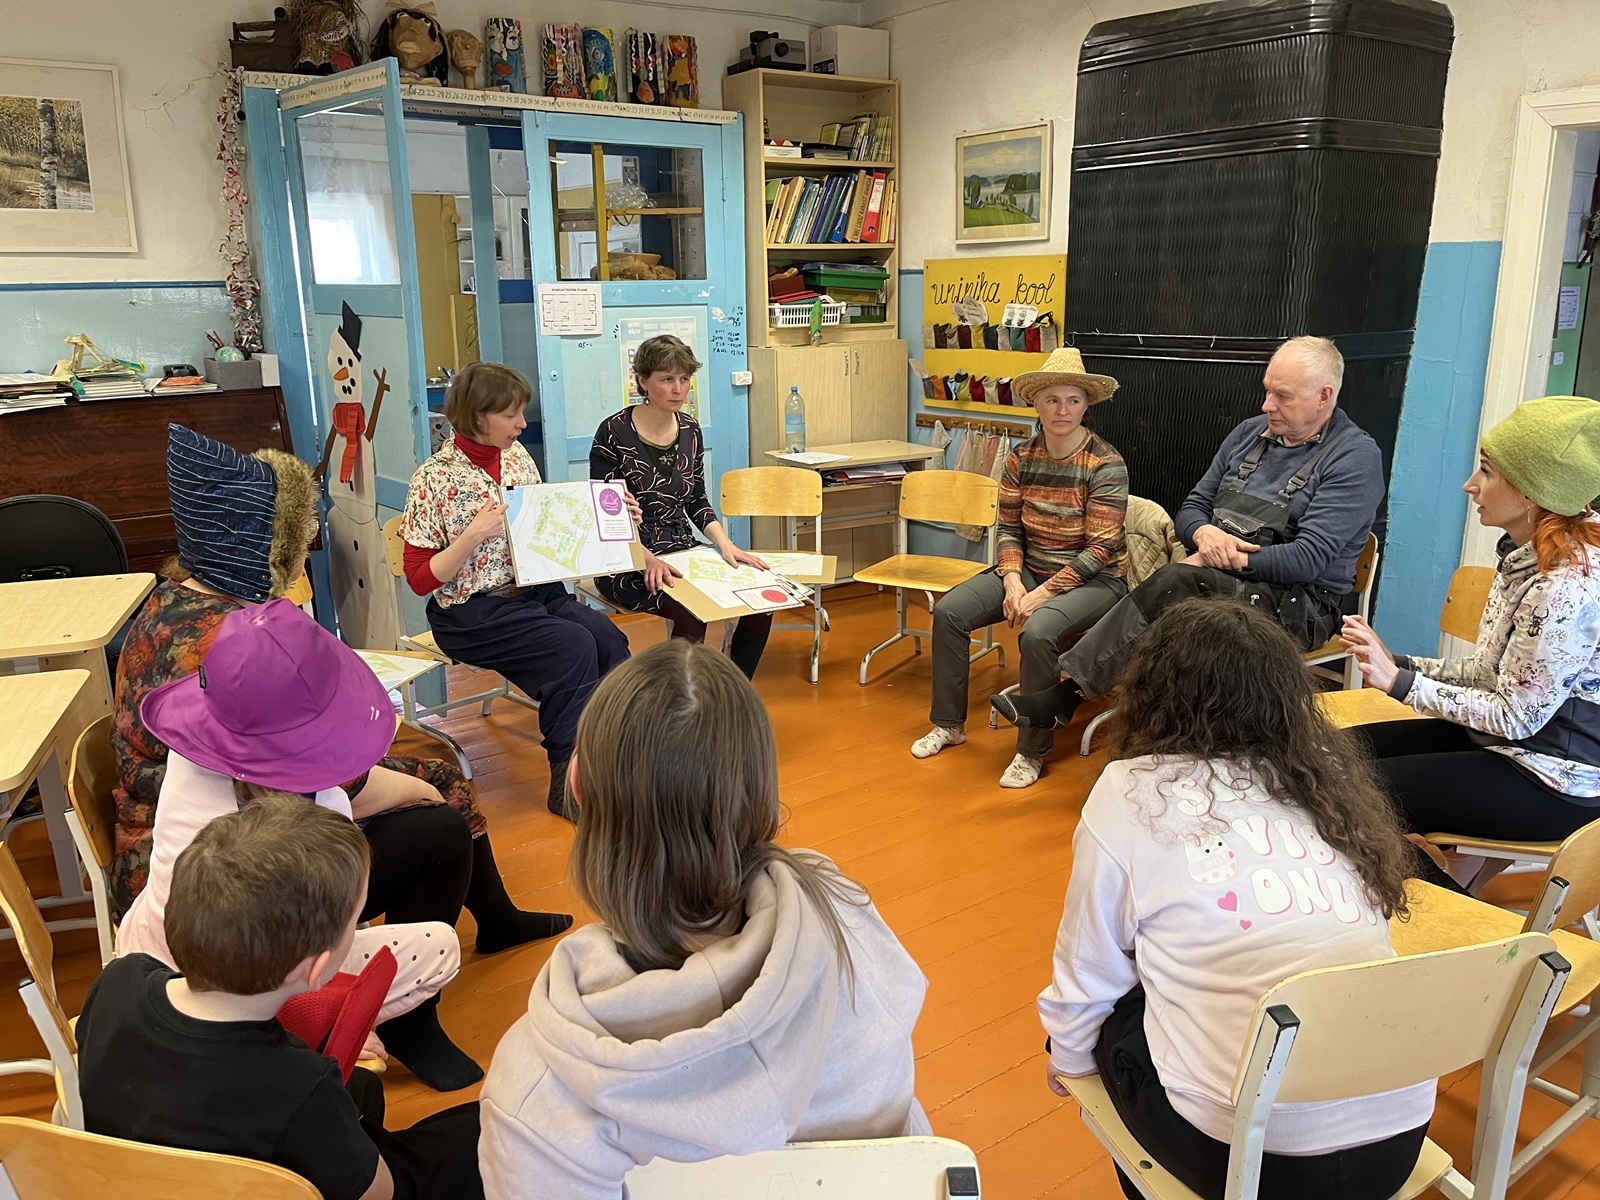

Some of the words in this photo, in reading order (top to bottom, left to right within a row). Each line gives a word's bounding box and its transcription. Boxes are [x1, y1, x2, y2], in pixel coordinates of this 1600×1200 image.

[254, 74, 260, 84] 2
[261, 75, 271, 85] 3
[273, 75, 278, 86] 4
[280, 76, 287, 87] 5
[1011, 273, 1055, 304] kool
[1232, 814, 1357, 872] VIB
